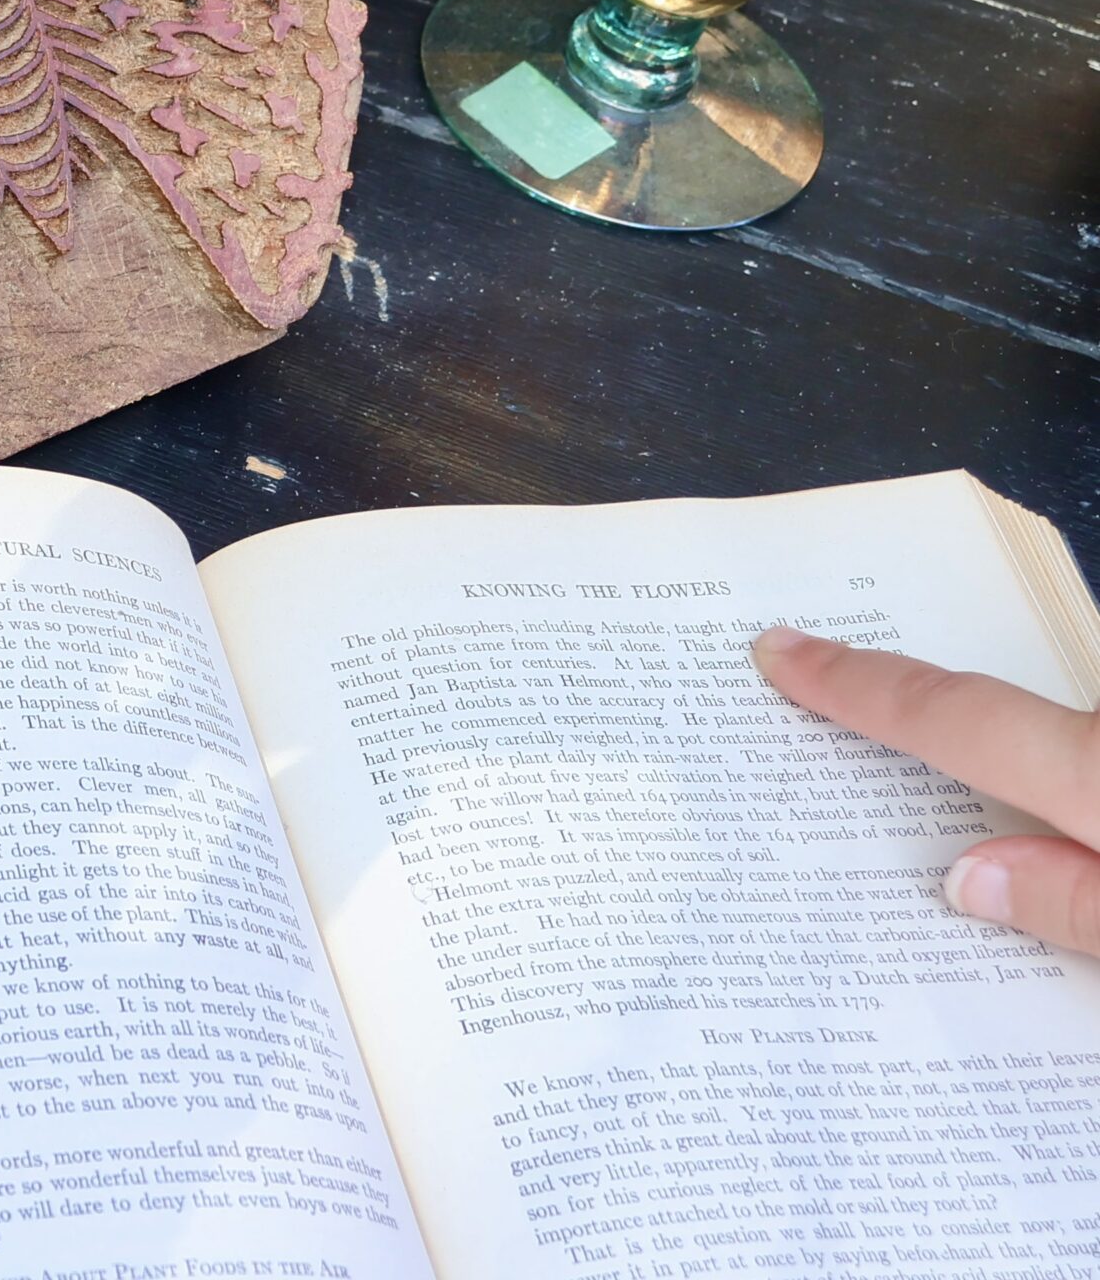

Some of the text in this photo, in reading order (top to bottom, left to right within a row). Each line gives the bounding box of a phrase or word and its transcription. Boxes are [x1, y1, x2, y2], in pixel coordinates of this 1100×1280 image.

[71, 547, 162, 582] SCIENCES
[11, 578, 26, 593] is
[29, 581, 78, 597] worth
[81, 587, 140, 611] nothing
[141, 599, 181, 622] unless
[460, 575, 875, 599] KNOWING THE FLOWERS 579
[7, 619, 40, 631] was
[43, 621, 62, 632] so
[65, 622, 133, 641] powerful
[135, 629, 166, 649] that
[340, 633, 377, 649] The
[380, 626, 409, 643] old
[411, 619, 519, 642] philosophers,
[521, 618, 596, 637] including
[600, 620, 670, 637] Aristotle,
[673, 619, 727, 637] taught
[730, 617, 765, 633] that
[793, 615, 822, 629] the
[342, 685, 401, 709] named
[405, 682, 439, 700] Jan
[443, 674, 517, 694] Baptista
[521, 676, 554, 687] van
[557, 673, 635, 691] Helmont,
[637, 674, 672, 688] who
[676, 678, 709, 688] was
[710, 674, 752, 688] born
[361, 729, 824, 766] had previously carefully weighed, in a pot containing 200
[389, 799, 984, 846] lost two ounces! It was therefore obvious that Aristotle and the others
[1, 982, 29, 996] we
[33, 976, 84, 994] know
[91, 973, 110, 990] of
[115, 971, 186, 994] nothing
[189, 976, 209, 991] to
[211, 975, 250, 996] beat
[253, 981, 284, 1003] this
[286, 989, 306, 1008] for
[309, 998, 330, 1018] the
[449, 964, 1065, 1013] This discovery was made 200 years later by a Dutch scientist, Jan van
[457, 991, 884, 1036] Ingenhousz, who published his researches in 1779.
[534, 1192, 997, 1246] importance attached to the mold or soil they root in?
